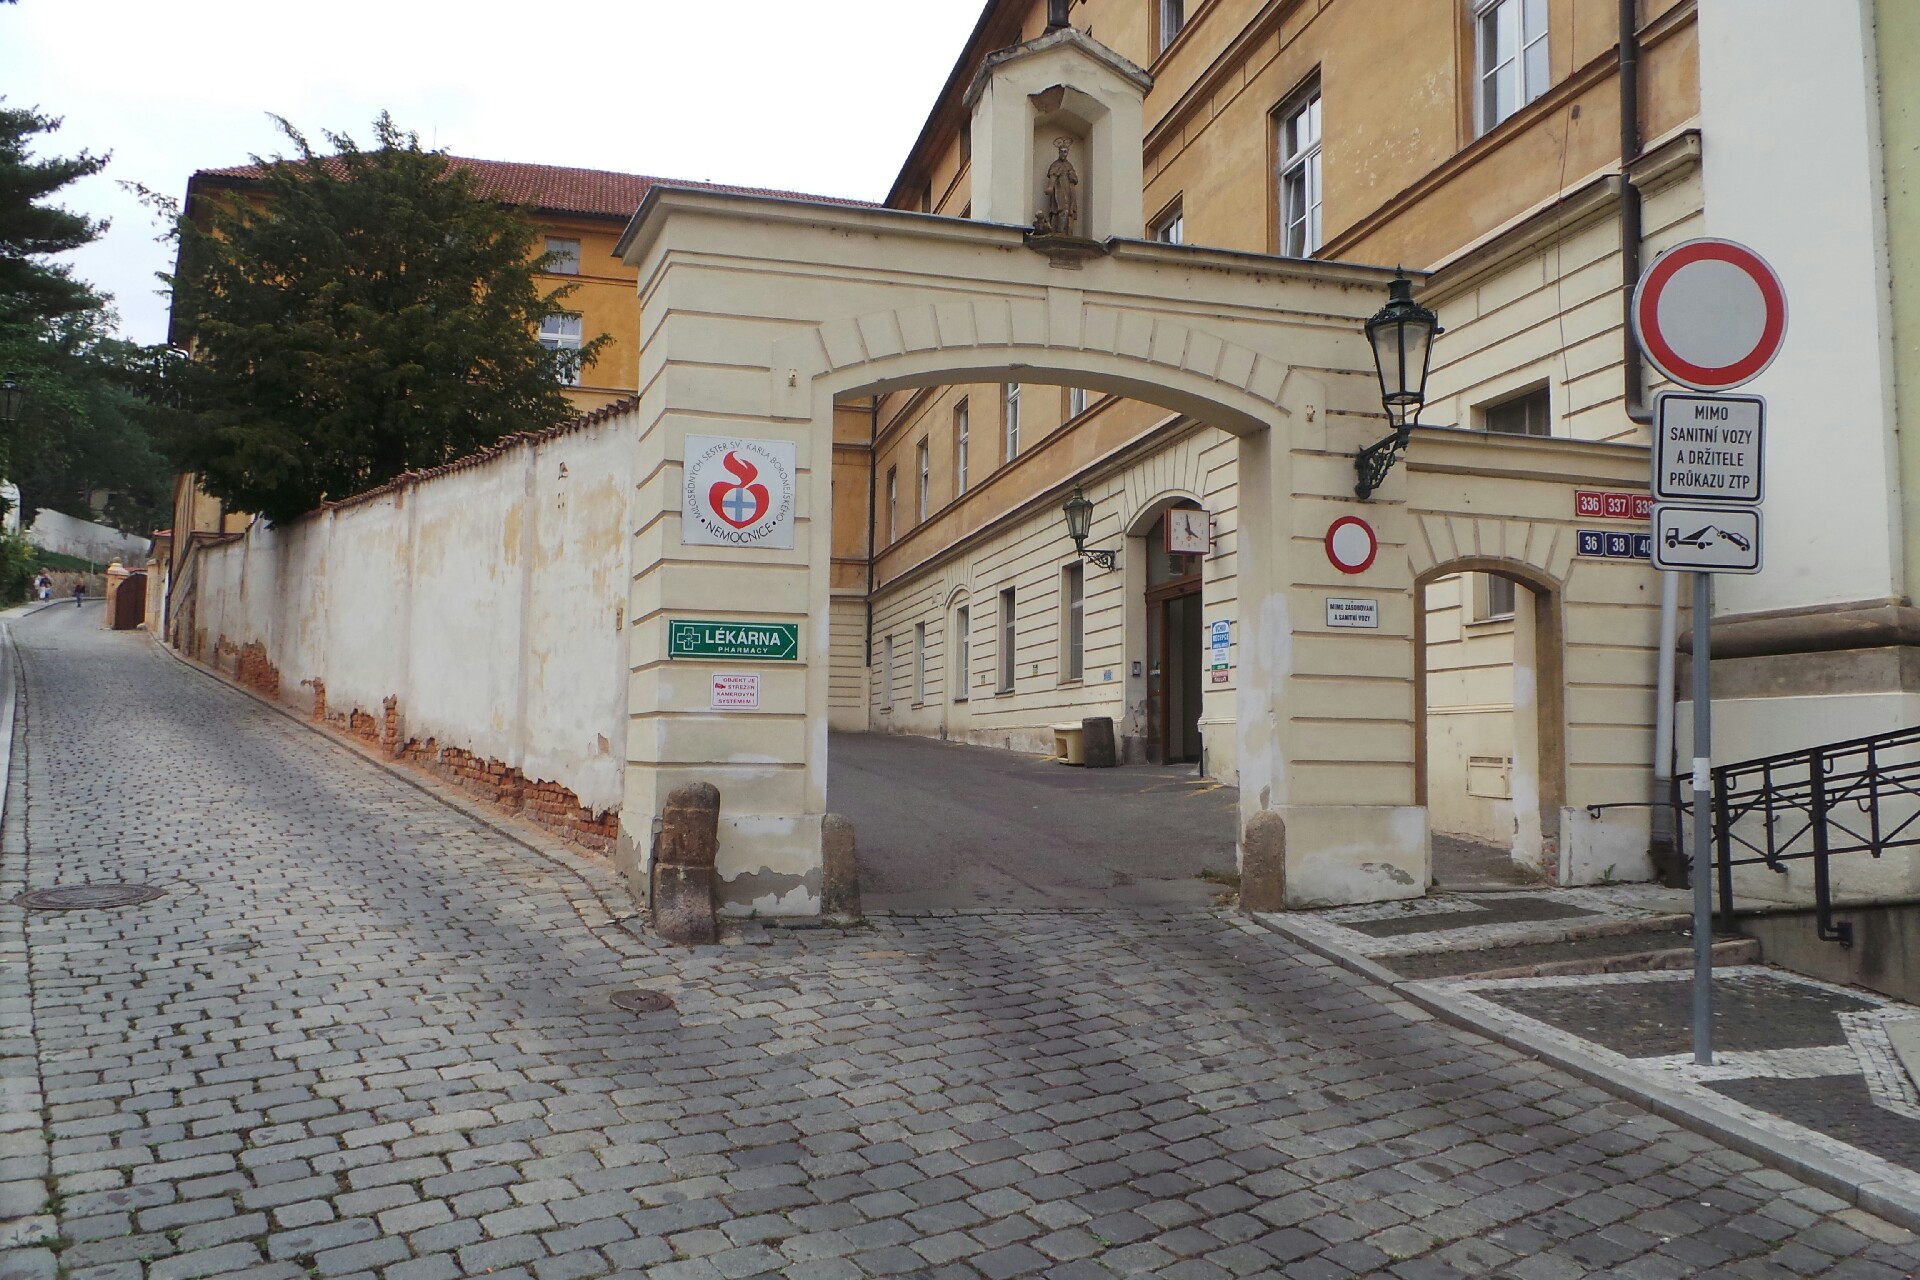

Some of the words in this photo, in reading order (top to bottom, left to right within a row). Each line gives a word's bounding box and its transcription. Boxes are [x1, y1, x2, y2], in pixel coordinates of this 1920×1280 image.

[1695, 405, 1729, 421] MIMO
[1670, 425, 1719, 443] SANITNÍ
[1722, 429, 1752, 445] VOZY
[702, 443, 728, 461] SESTER
[746, 443, 770, 460] KARLA
[1676, 449, 1684, 464] A
[1689, 448, 1744, 466] DRŽITELE
[1669, 469, 1725, 488] PRŮKAZU
[1729, 474, 1750, 489] ZTP
[1581, 496, 1599, 511] 336
[1608, 498, 1626, 513] 337
[705, 520, 773, 543] NEMOCNICE
[1585, 536, 1598, 551] 36
[1612, 537, 1625, 552] 38
[1329, 603, 1344, 611] MIMO
[705, 627, 780, 646] LÉKÁRNA
[718, 646, 768, 654] PHARMACY
